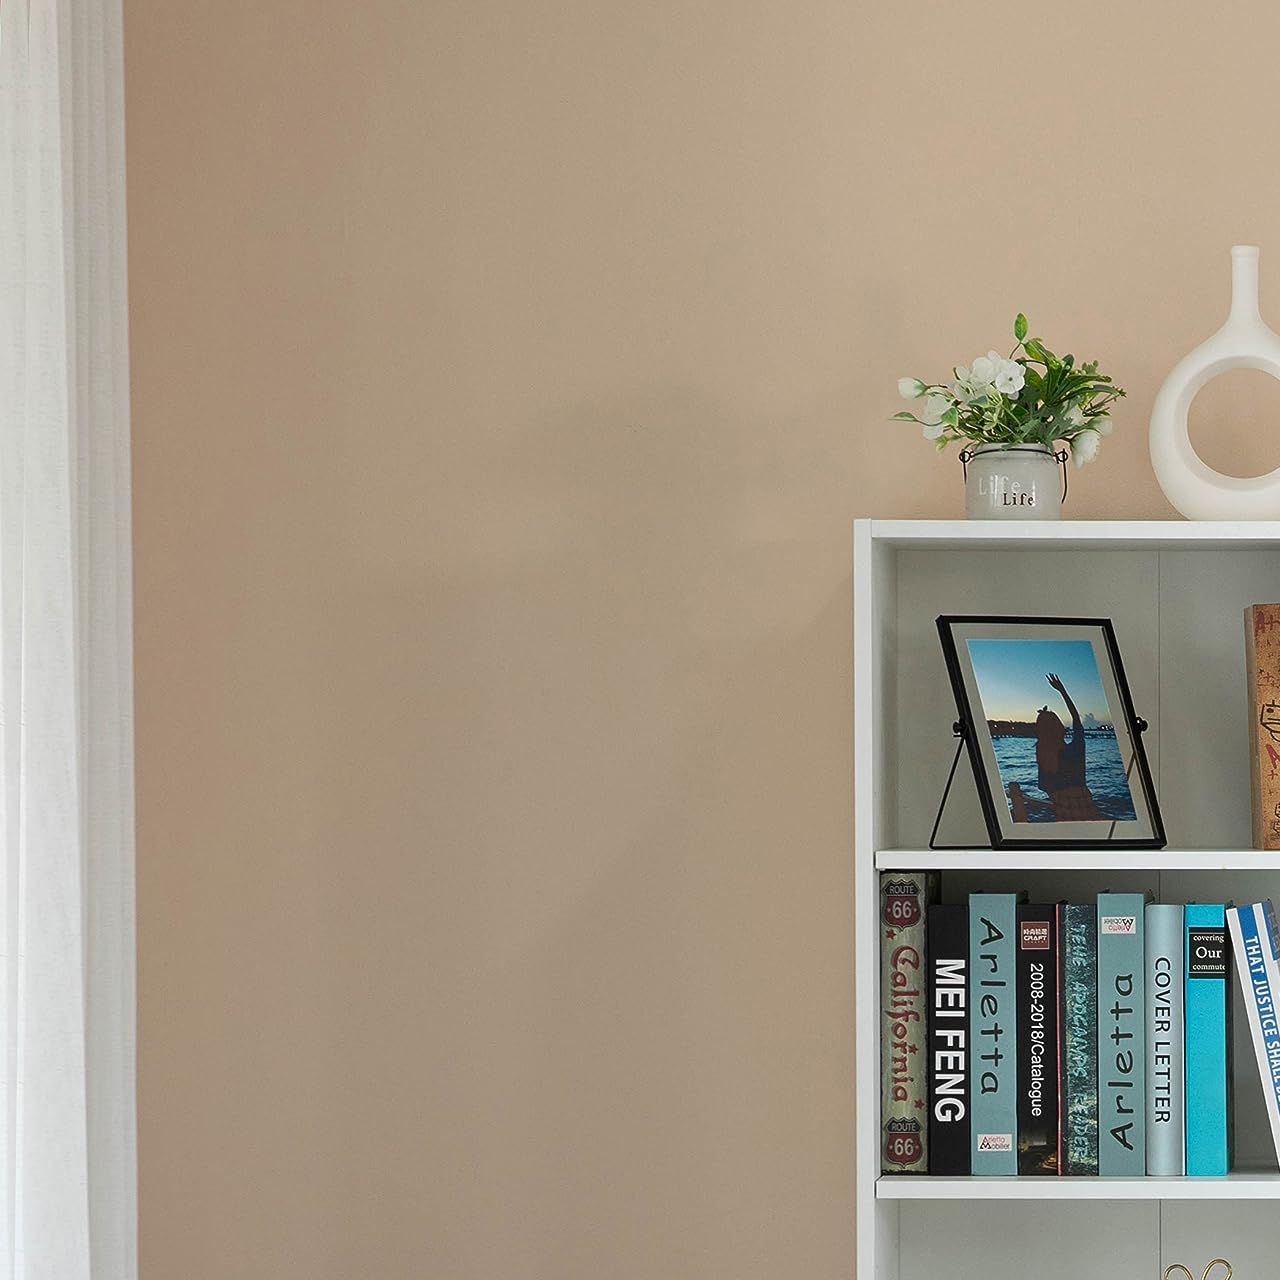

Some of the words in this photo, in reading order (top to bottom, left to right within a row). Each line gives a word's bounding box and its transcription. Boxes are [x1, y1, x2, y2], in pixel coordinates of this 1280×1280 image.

[1003, 493, 1034, 506] Life
[889, 885, 915, 895] ROUTE
[892, 900, 912, 920] 66
[1193, 934, 1225, 944] covering
[1195, 946, 1222, 959] Our
[1246, 936, 1264, 974] THAT
[935, 958, 966, 1018] MEI
[980, 917, 1006, 1095] Arletta
[1154, 957, 1171, 1033] COVER
[1254, 979, 1277, 1037] JUSTICE
[885, 944, 919, 1103] California
[1028, 963, 1044, 1117] 2008-2018/Catalogue
[934, 1030, 966, 1122] FENG
[1107, 973, 1134, 1151] Arletta
[1154, 1041, 1171, 1123] LETTER
[891, 1121, 916, 1132] ROUTE
[893, 1138, 914, 1156] 66
